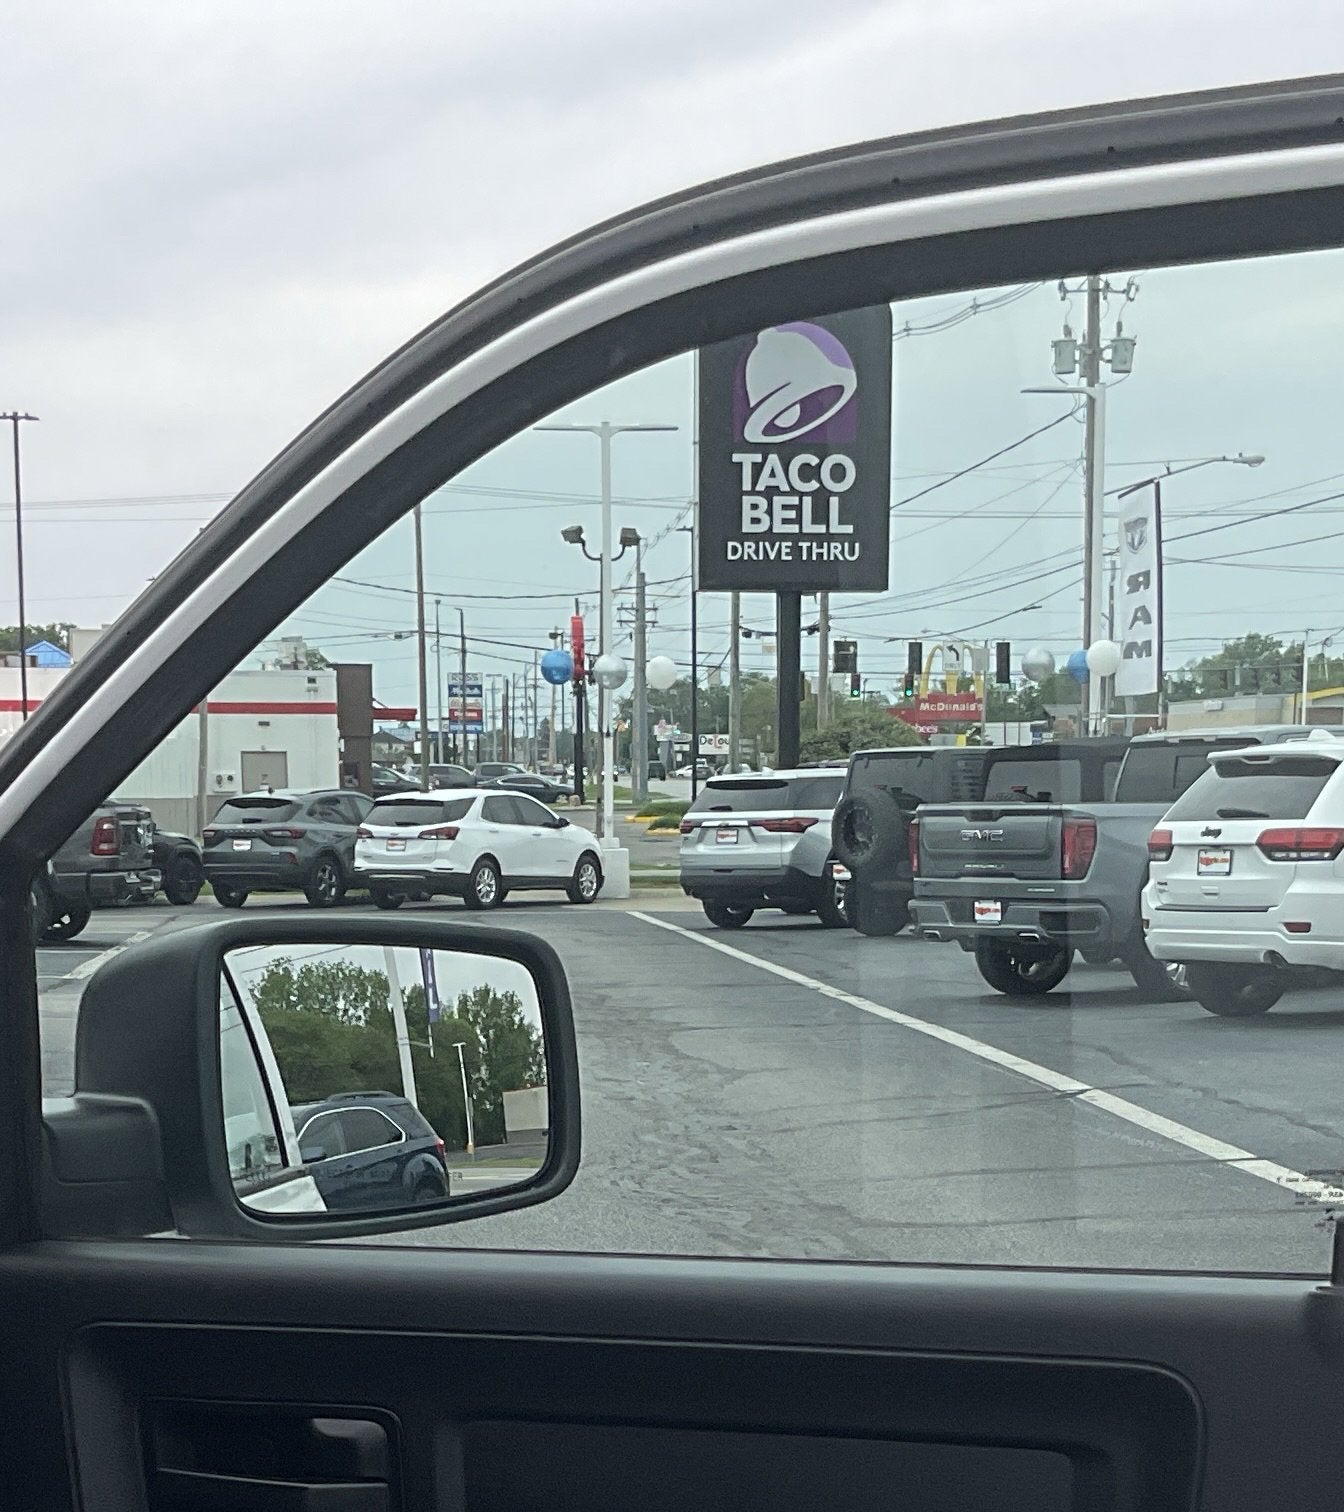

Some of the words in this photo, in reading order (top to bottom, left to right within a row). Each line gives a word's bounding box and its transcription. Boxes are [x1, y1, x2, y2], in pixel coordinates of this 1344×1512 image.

[732, 453, 856, 492] TACO
[742, 496, 853, 533] BELL
[727, 541, 792, 561] DRIVE
[798, 542, 859, 561] THRU
[960, 829, 1004, 842] GMC
